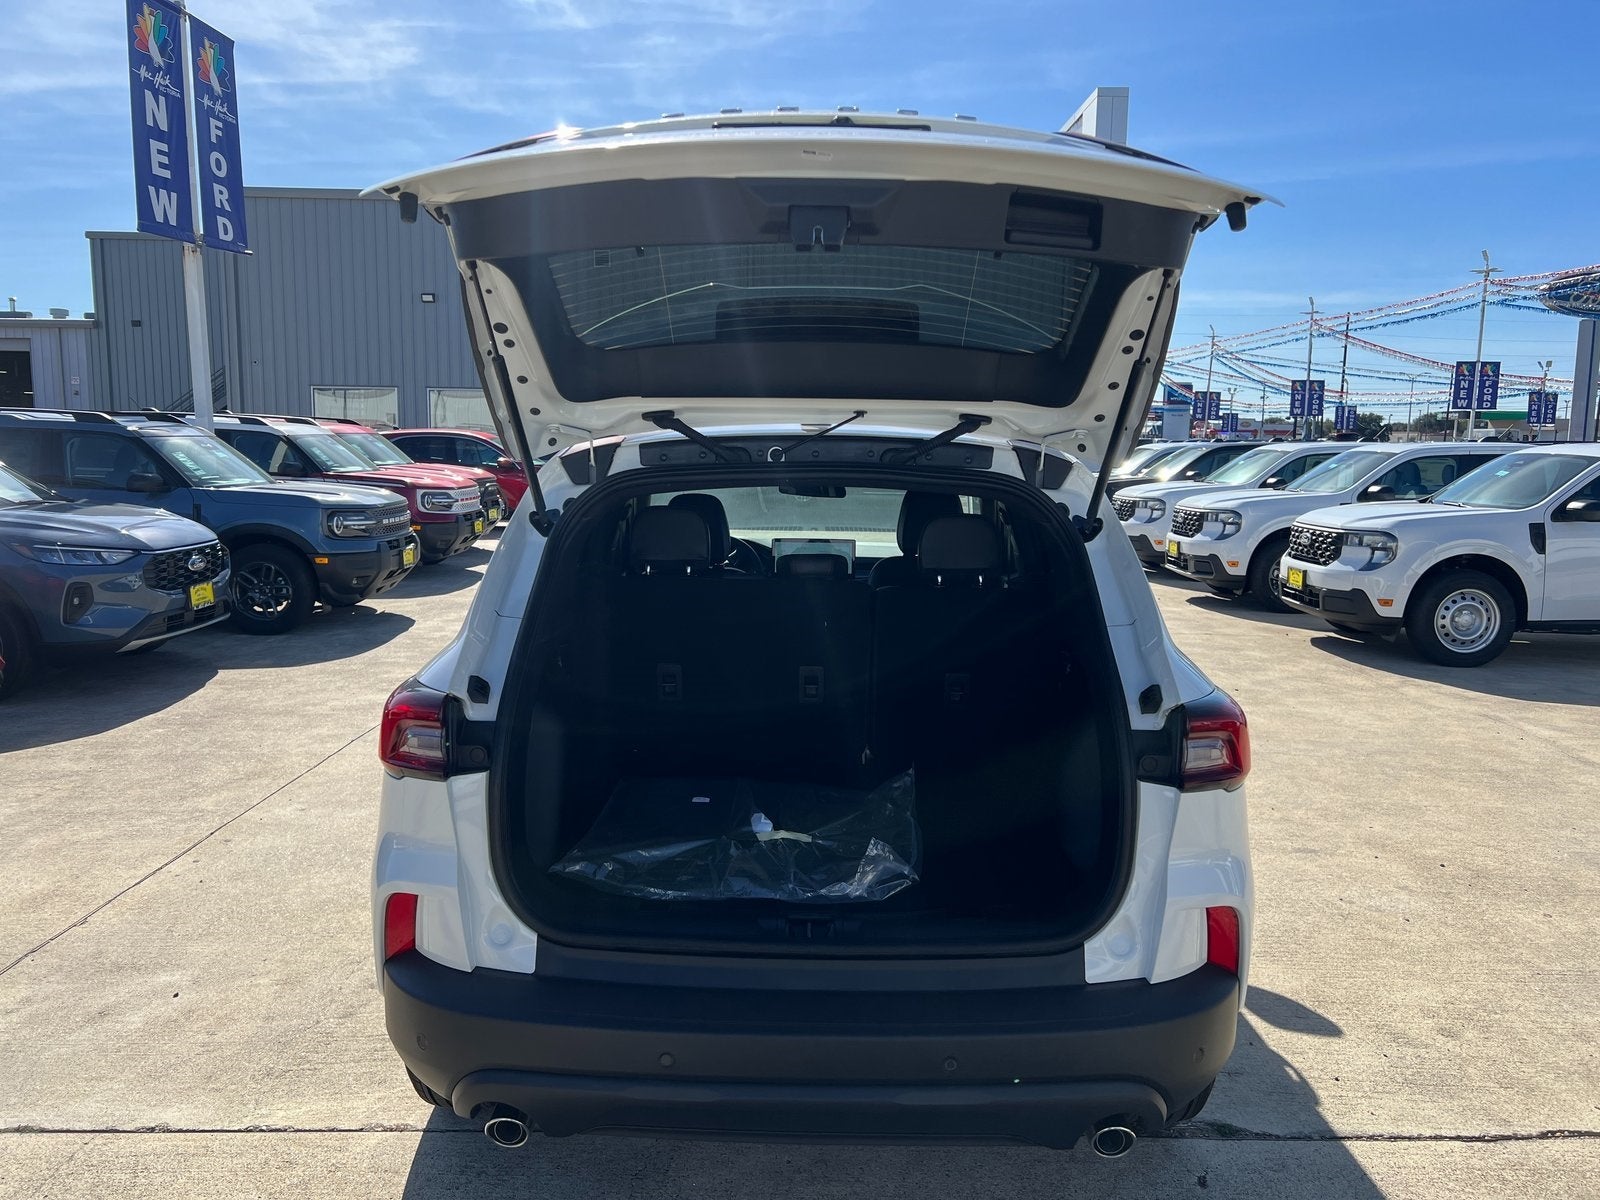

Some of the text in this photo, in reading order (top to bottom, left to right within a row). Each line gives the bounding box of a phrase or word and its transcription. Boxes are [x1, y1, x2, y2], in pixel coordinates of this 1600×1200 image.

[153, 71, 181, 89] Haik
[213, 99, 236, 116] Haik
[144, 88, 178, 227] NEW
[208, 116, 234, 242] FORD
[1293, 393, 1302, 415] NEW
[1311, 394, 1320, 415] FORD
[1457, 380, 1469, 408] NEW
[1482, 380, 1493, 409] FORD
[1195, 403, 1203, 419] NEW
[1530, 404, 1538, 423] NEW
[1546, 404, 1554, 423] FORD
